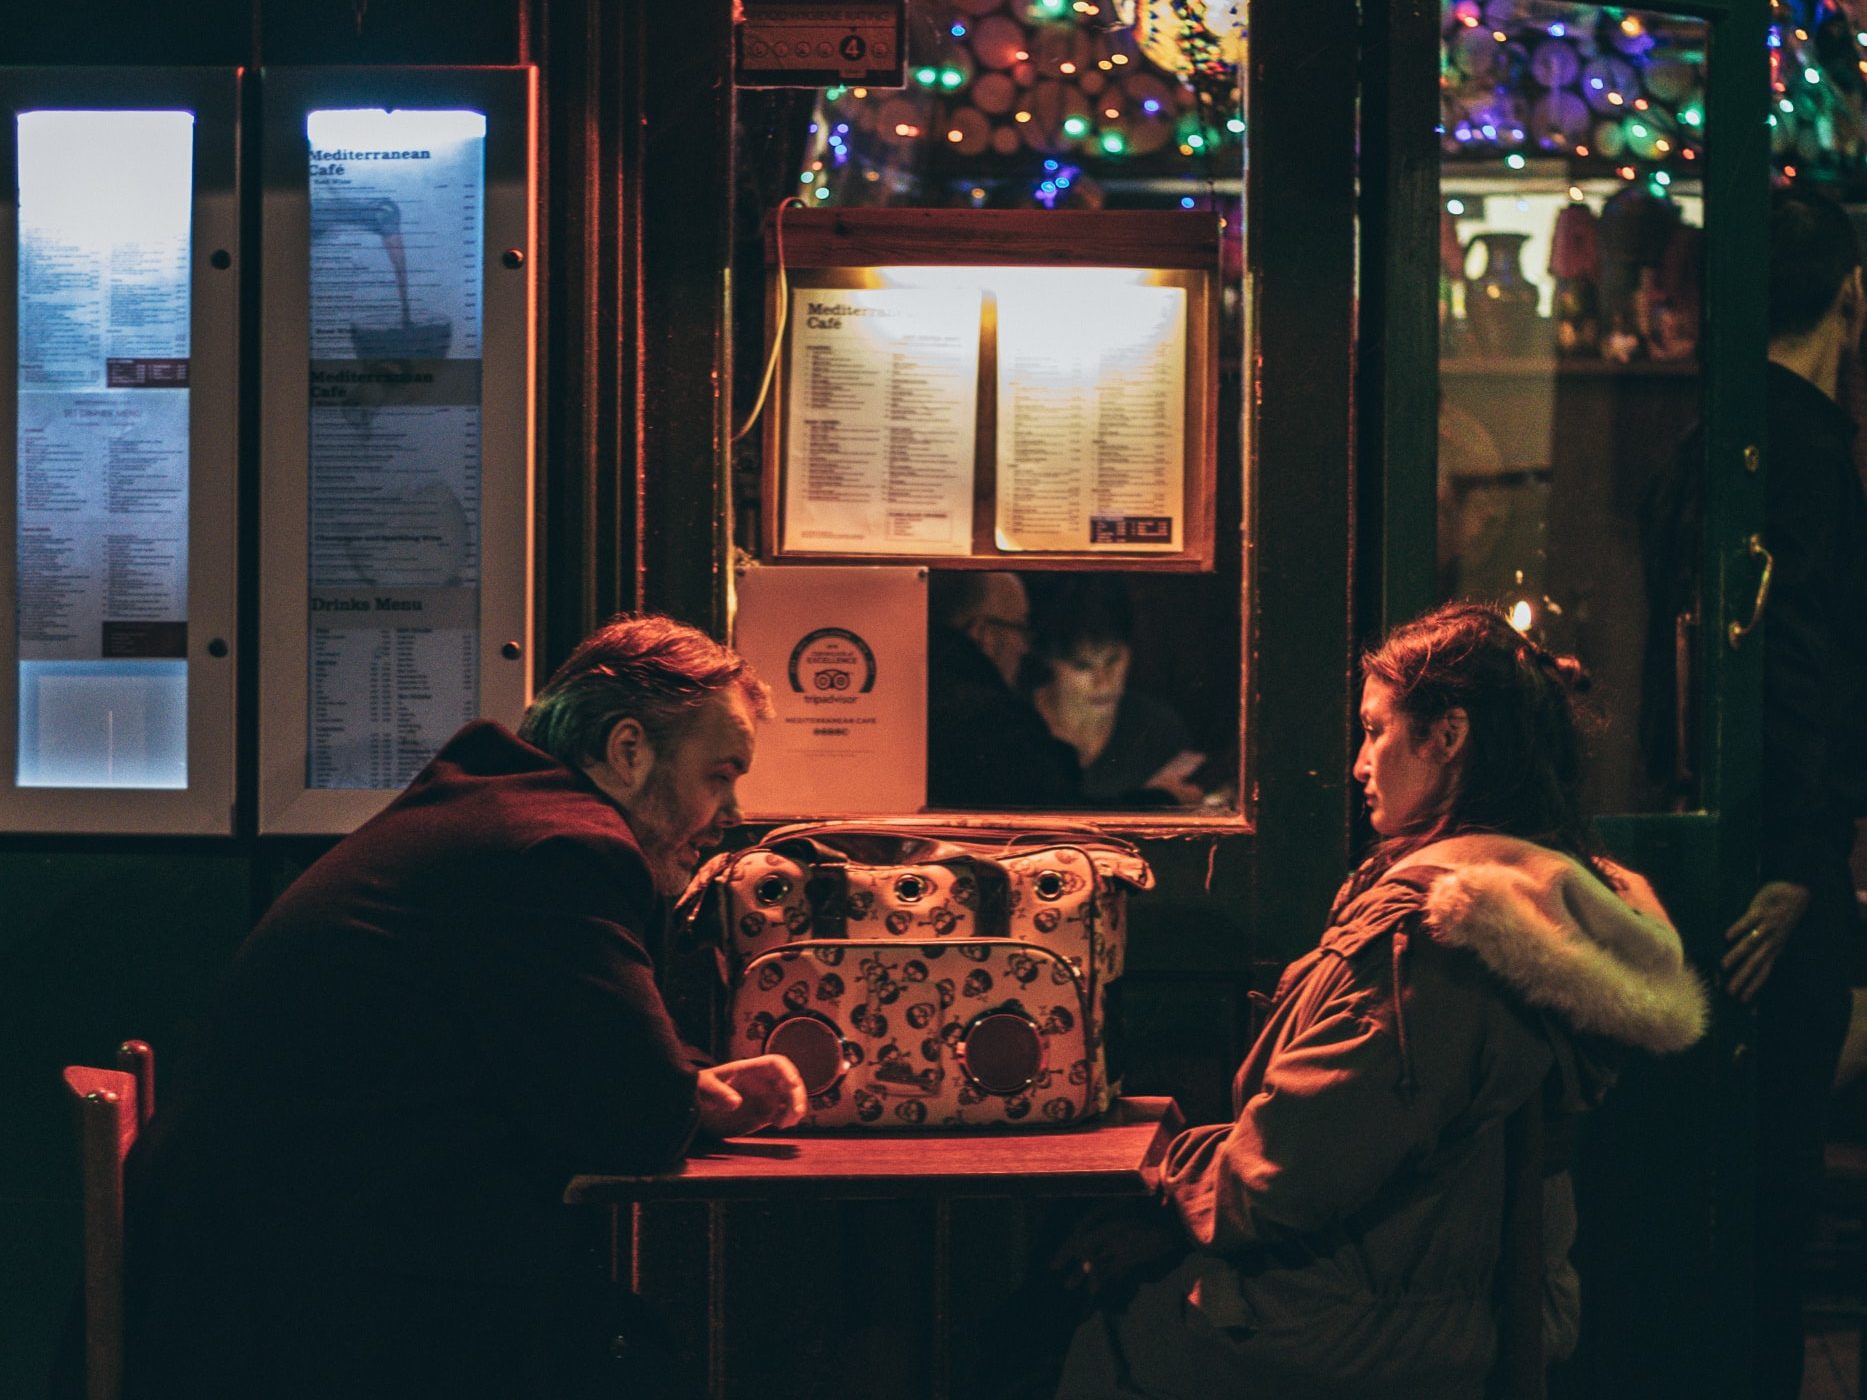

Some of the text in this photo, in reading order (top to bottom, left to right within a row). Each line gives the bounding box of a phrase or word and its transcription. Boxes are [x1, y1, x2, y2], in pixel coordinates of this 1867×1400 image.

[845, 39, 860, 57] 4
[309, 149, 431, 161] Mediterranean
[309, 163, 345, 176] Café
[807, 317, 842, 329] Café
[311, 597, 423, 611] Drinks Menu
